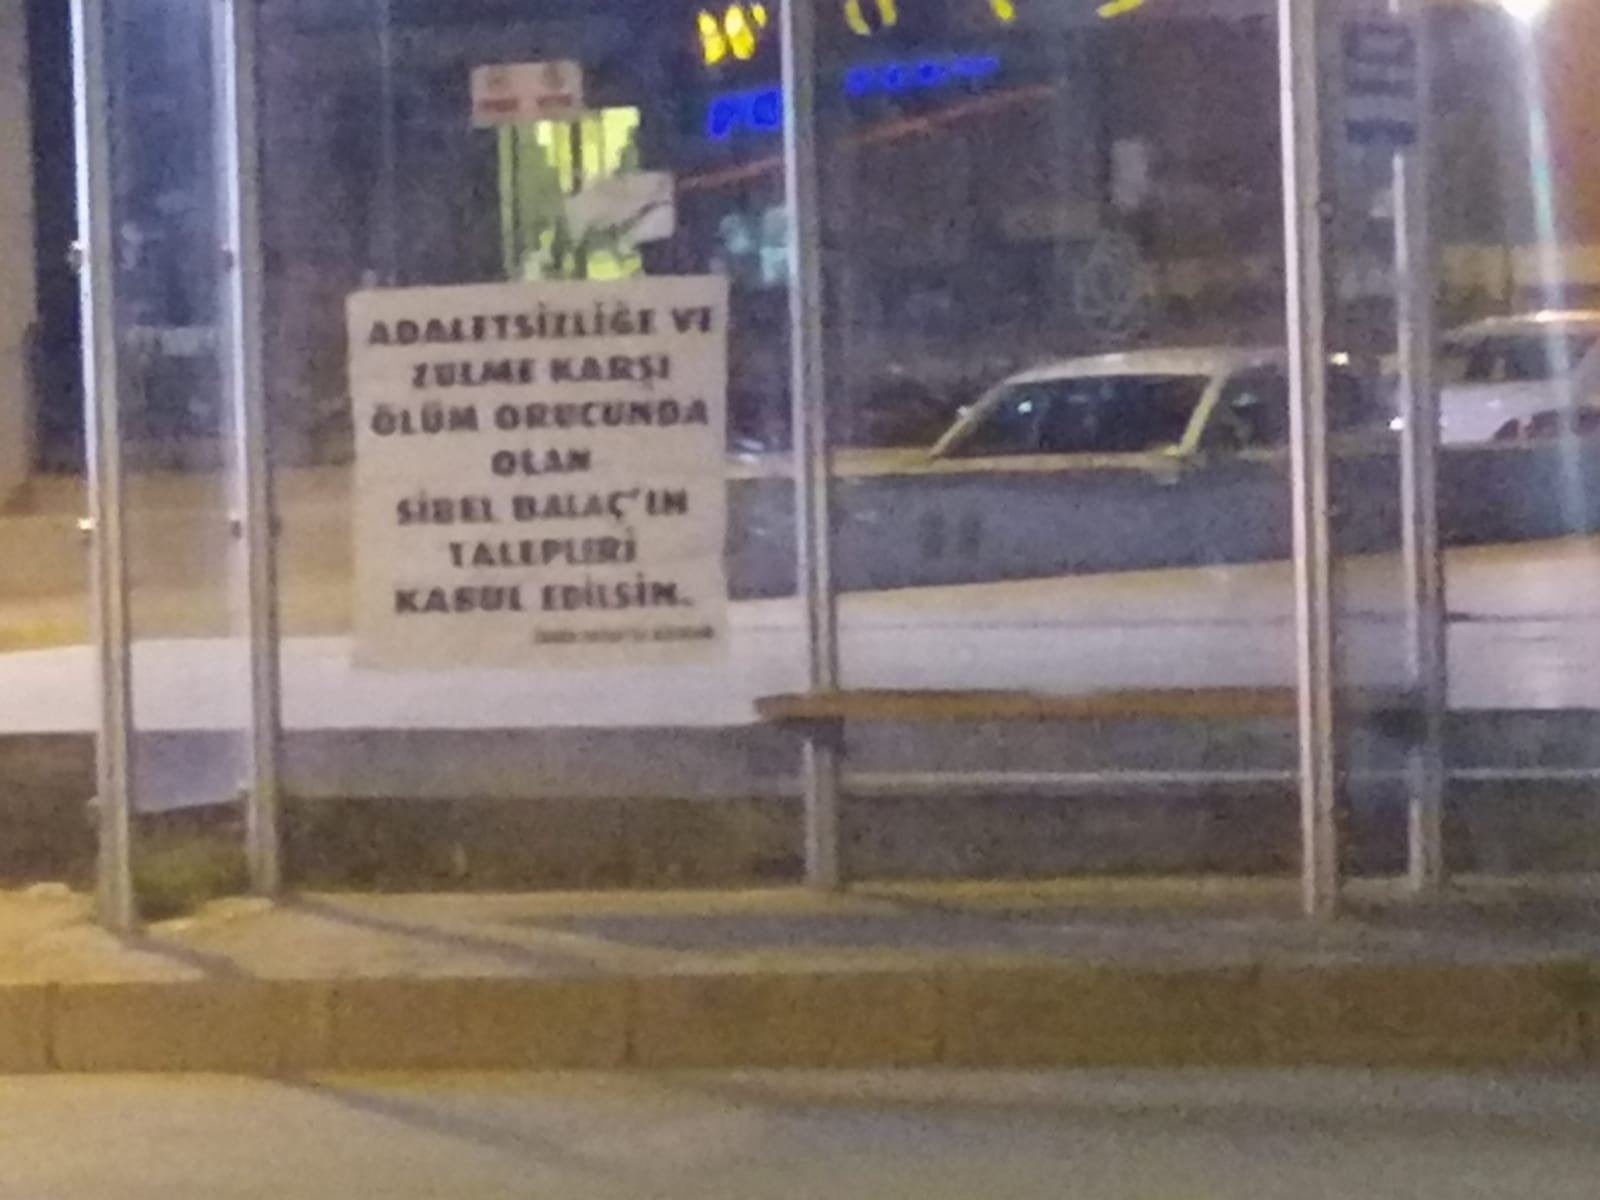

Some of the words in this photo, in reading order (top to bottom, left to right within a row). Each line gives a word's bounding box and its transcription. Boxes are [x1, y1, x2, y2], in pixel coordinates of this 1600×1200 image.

[368, 301, 656, 346] ADALETSİZLİĞE
[550, 355, 670, 390] KARŞI
[370, 402, 479, 436] ÖLÜM
[494, 400, 708, 430] ORUCUNDA
[491, 449, 591, 476] OLAN
[396, 490, 496, 525] SİBEL
[450, 527, 635, 567] TALEPLERİ
[394, 586, 523, 613] KABUL
